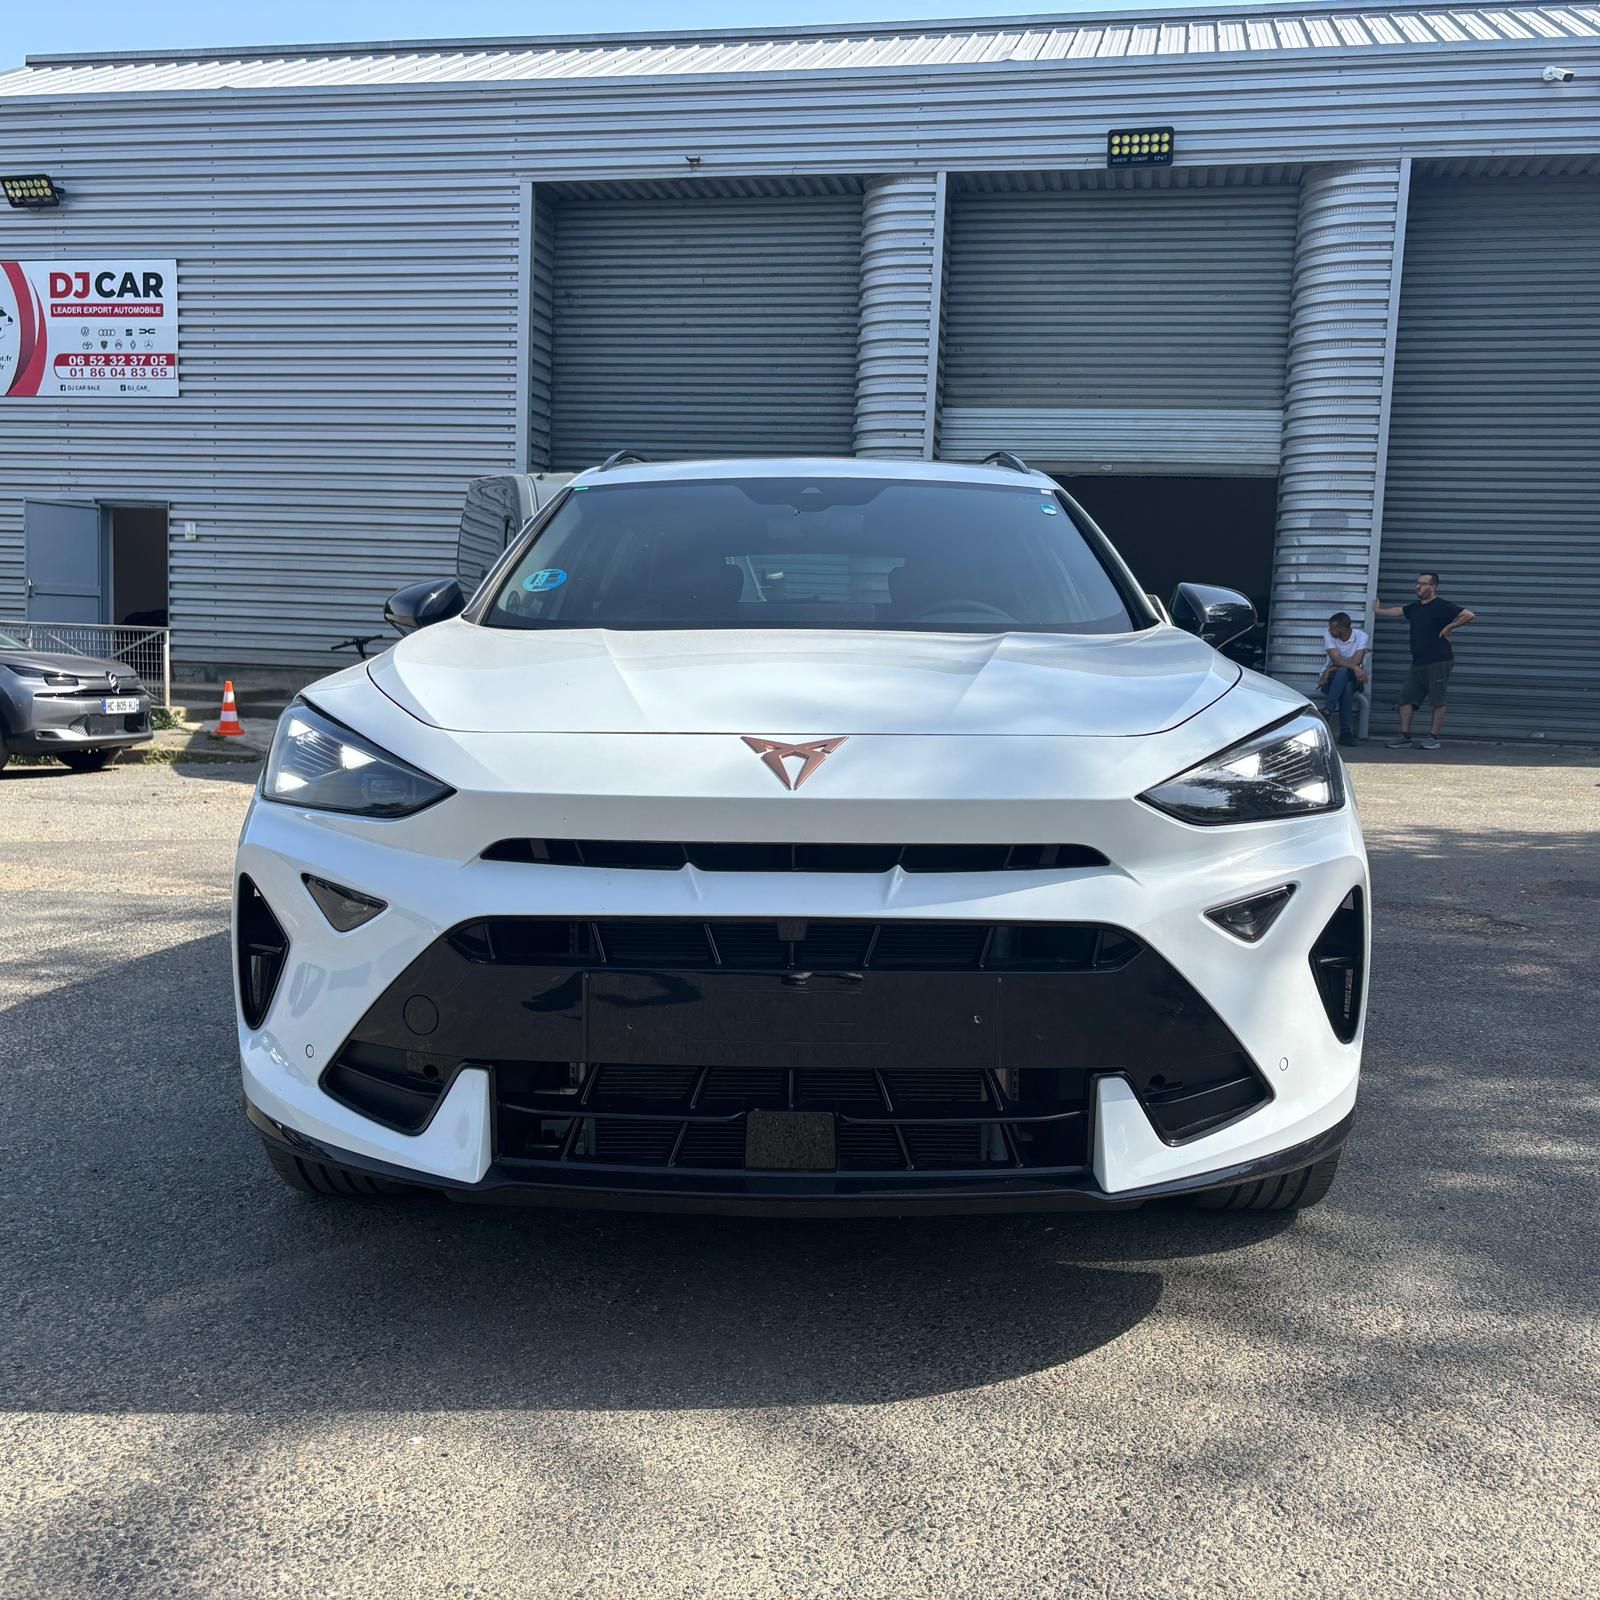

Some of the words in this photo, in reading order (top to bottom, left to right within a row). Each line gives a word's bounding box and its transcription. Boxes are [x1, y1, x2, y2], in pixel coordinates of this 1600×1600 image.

[49, 272, 91, 299] DJ
[94, 272, 164, 298] CAR
[53, 306, 82, 314] LEADER
[83, 306, 113, 314] EXPORT
[114, 306, 161, 314] AUTOMOBILE
[68, 356, 85, 365] 06
[89, 356, 105, 365] 52
[109, 356, 125, 365] 32
[130, 356, 145, 365] 37
[150, 356, 167, 365] 05
[69, 368, 85, 377] 01
[90, 368, 105, 377] 86
[110, 368, 126, 377] 04
[131, 368, 146, 377] 83
[151, 368, 168, 377] 65
